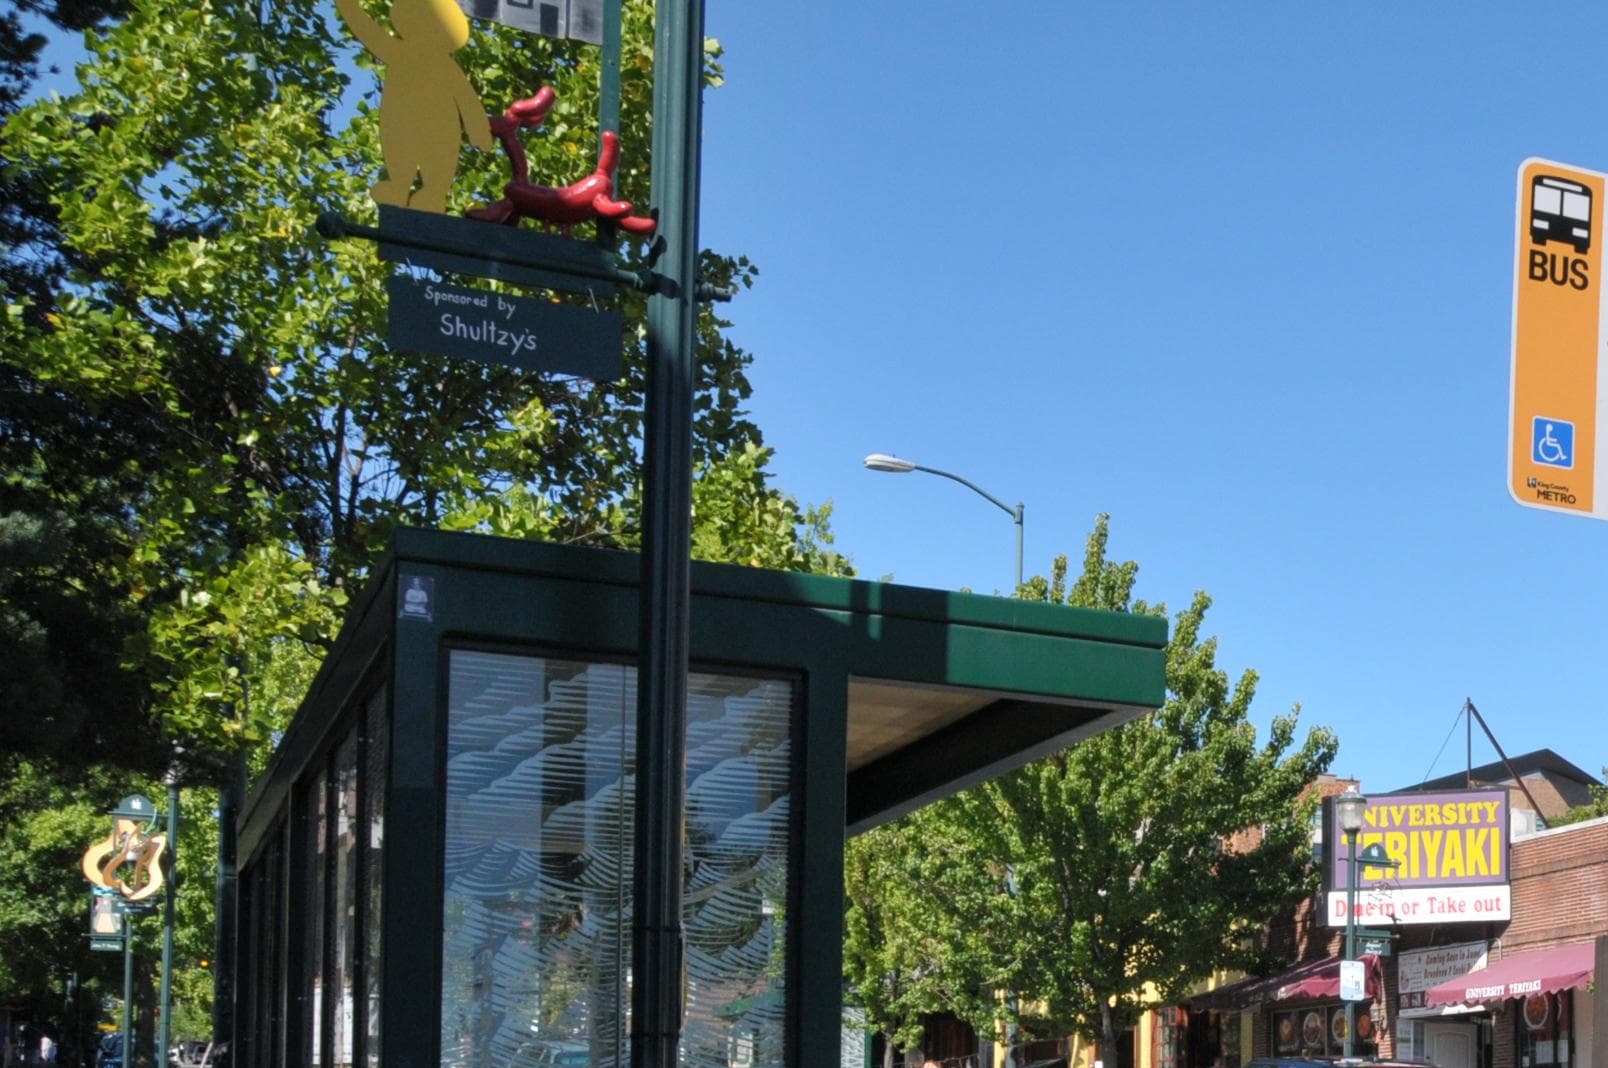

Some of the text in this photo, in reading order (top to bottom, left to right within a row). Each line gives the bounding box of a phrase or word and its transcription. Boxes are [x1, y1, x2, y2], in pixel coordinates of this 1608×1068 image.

[1528, 249, 1589, 291] BUS
[425, 286, 516, 319] Sponsored by
[440, 313, 537, 355] Shultzy's
[1536, 488, 1576, 504] METRO
[1362, 801, 1500, 828] NIVERSITY
[1335, 899, 1374, 917] Dne
[1401, 899, 1420, 915] or
[1426, 896, 1467, 914] Take
[1473, 896, 1502, 913] out
[1466, 980, 1541, 999] UNIVERSITY TERIYAKI
